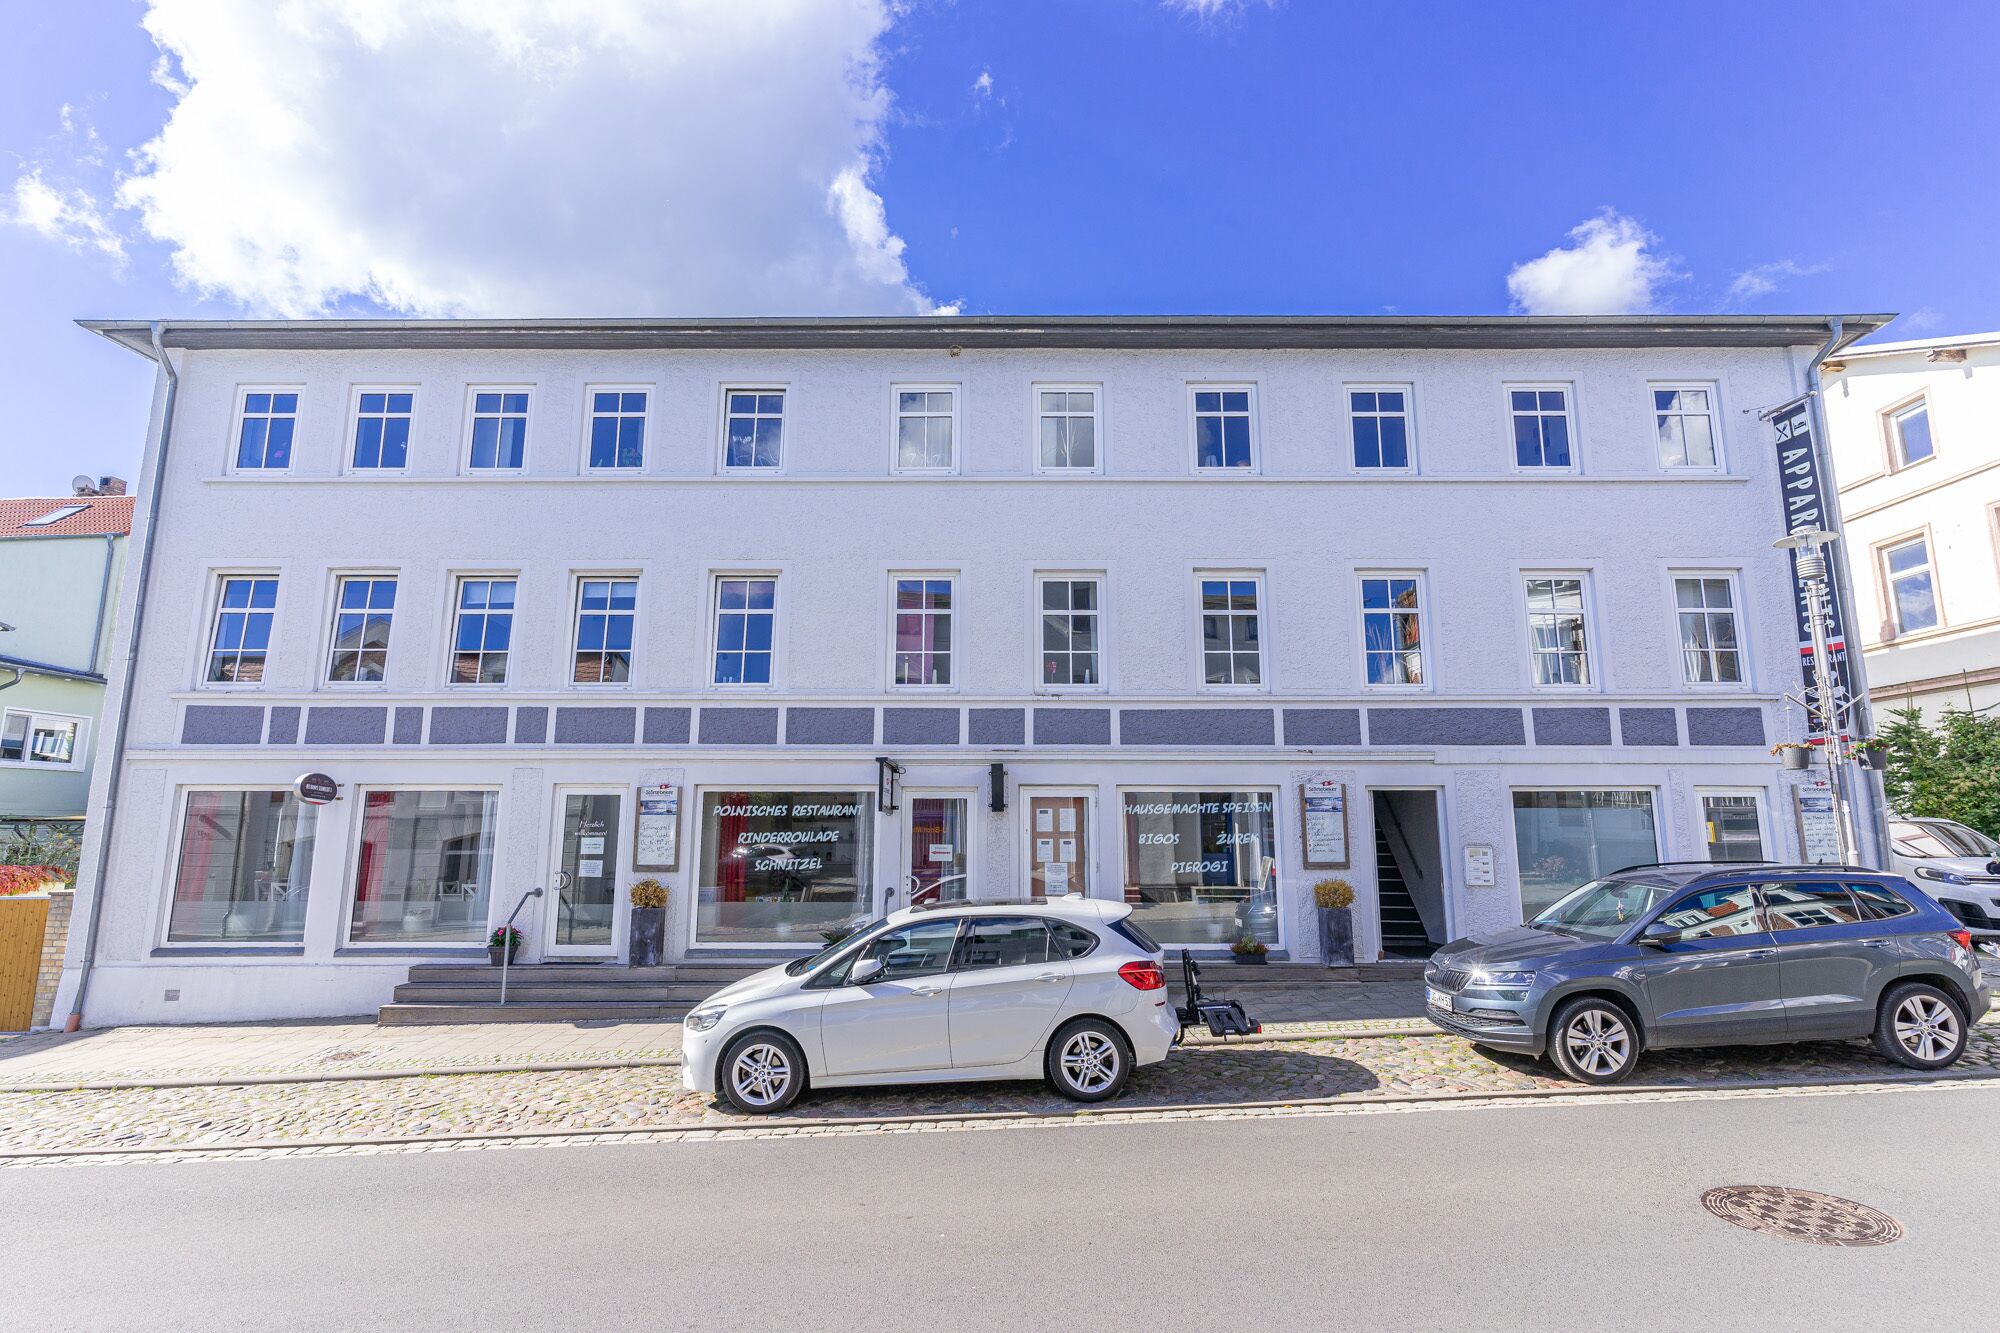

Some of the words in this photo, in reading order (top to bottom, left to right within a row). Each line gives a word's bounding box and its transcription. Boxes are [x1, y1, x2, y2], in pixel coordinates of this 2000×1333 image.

[1802, 651, 1846, 666] RESRANT
[712, 804, 788, 817] POLNISCHES
[791, 804, 865, 817] RESTAURANT
[1123, 803, 1220, 815] HAUSGEMACHTE
[1222, 801, 1272, 814] SPEISEN
[738, 830, 840, 844] RINDERROULADE
[1138, 833, 1181, 845] BIGOS
[754, 857, 823, 871] SCHNITZEL
[1170, 860, 1229, 874] PIEROGI
